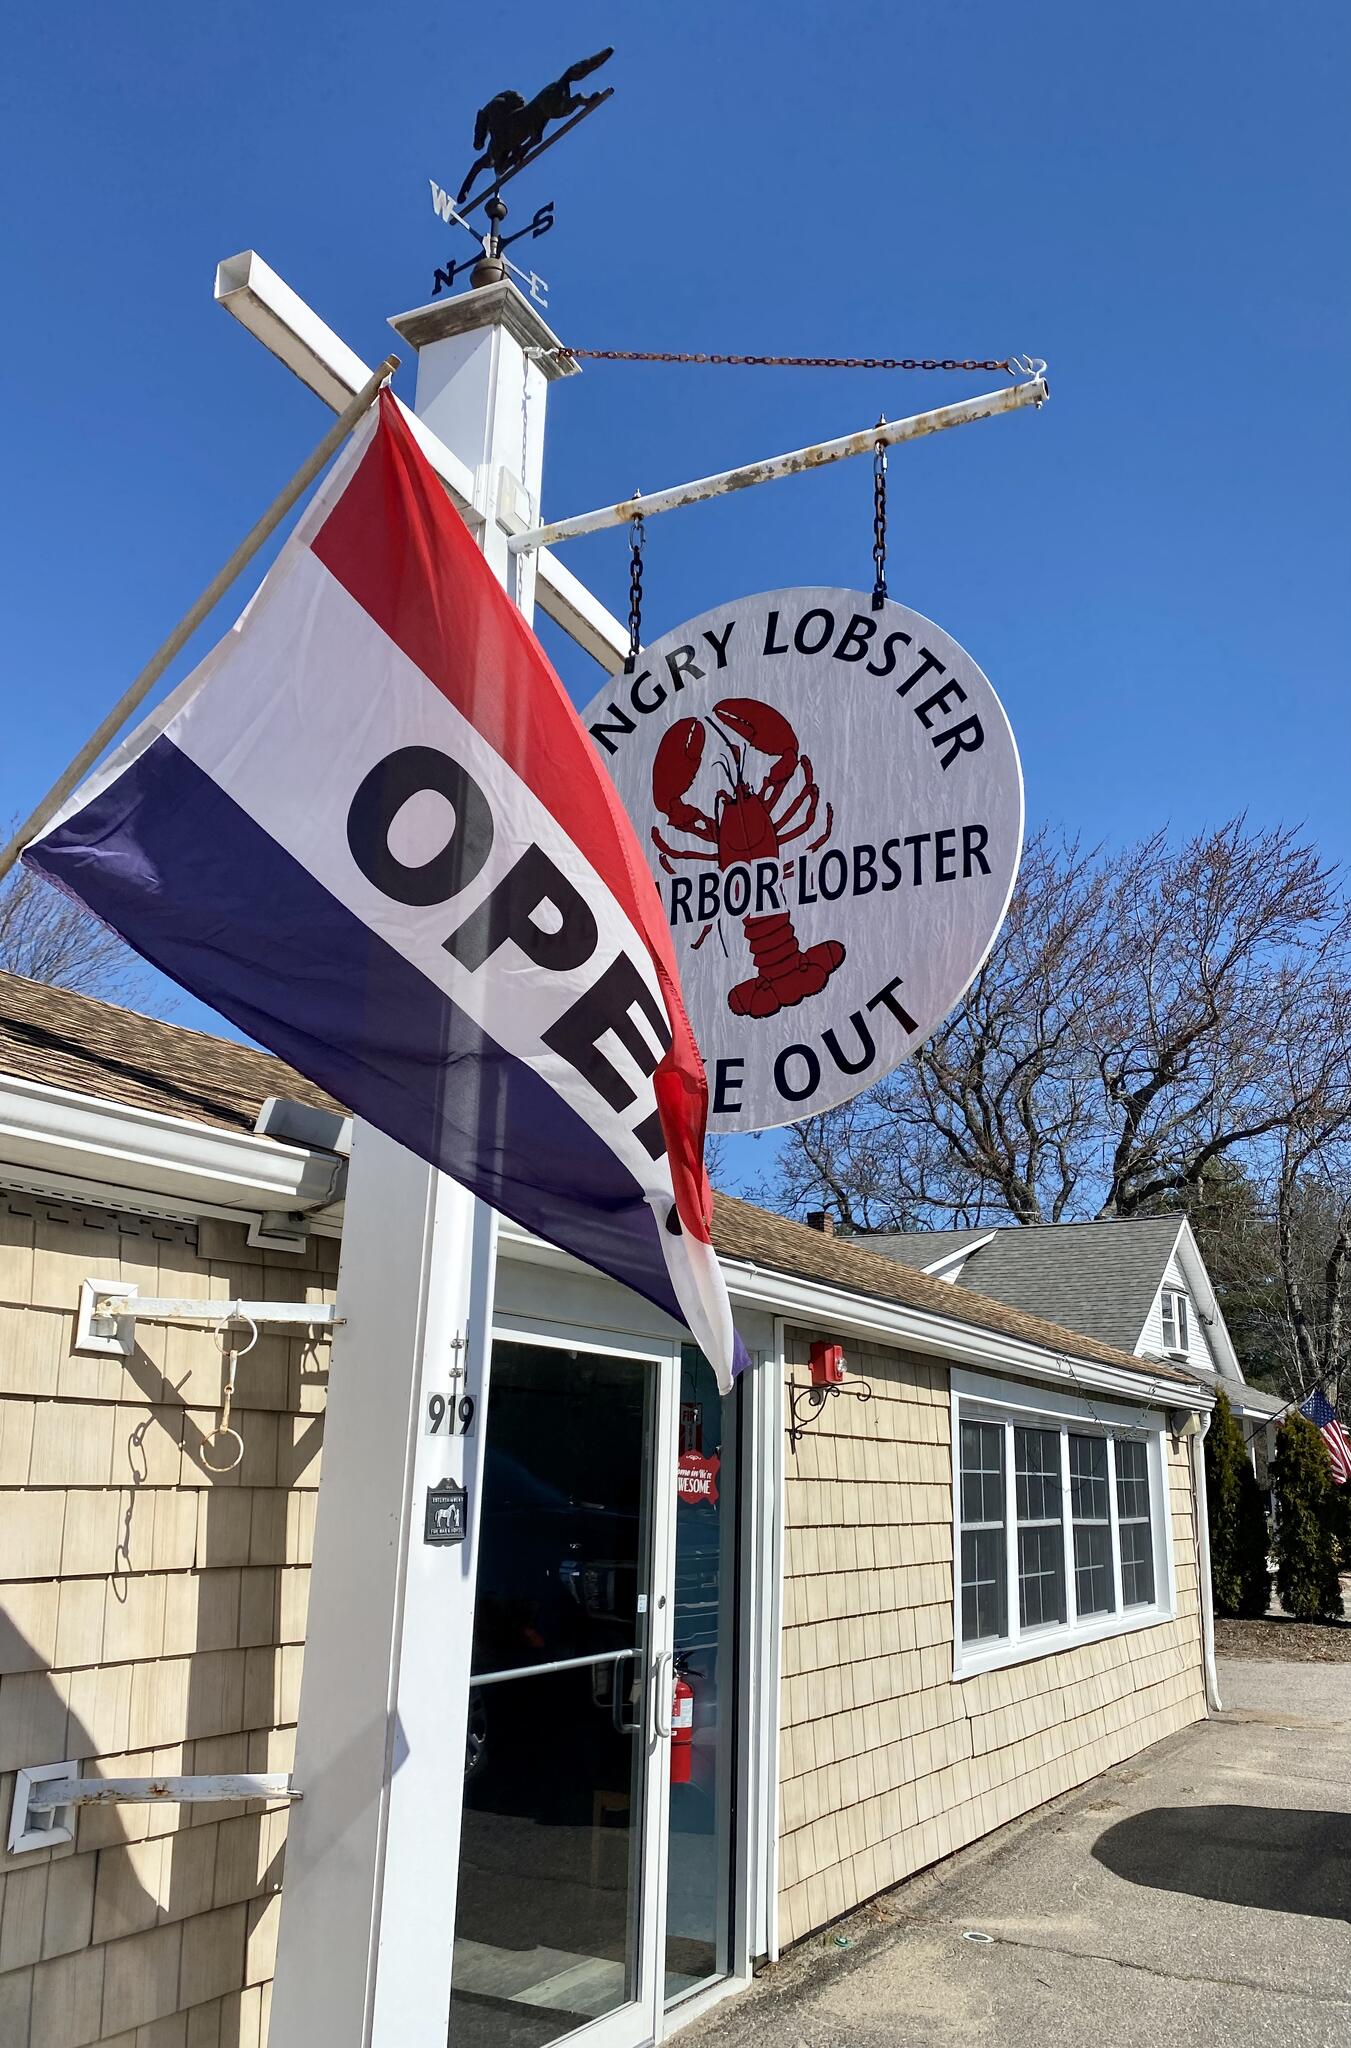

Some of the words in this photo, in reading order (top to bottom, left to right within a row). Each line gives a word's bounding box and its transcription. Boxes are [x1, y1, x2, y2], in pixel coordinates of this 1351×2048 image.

[428, 179, 458, 223] W
[532, 201, 554, 239] S
[431, 259, 456, 296] N
[529, 270, 549, 309] E
[588, 620, 737, 756] NGRY
[762, 607, 986, 772] LOBSTER
[654, 859, 783, 926] RBOR
[798, 823, 992, 906] LOBSTER
[346, 744, 683, 1236] OPE
[773, 976, 921, 1102] OUT
[428, 1394, 475, 1435] 919
[677, 1477, 712, 1495] WESOME
